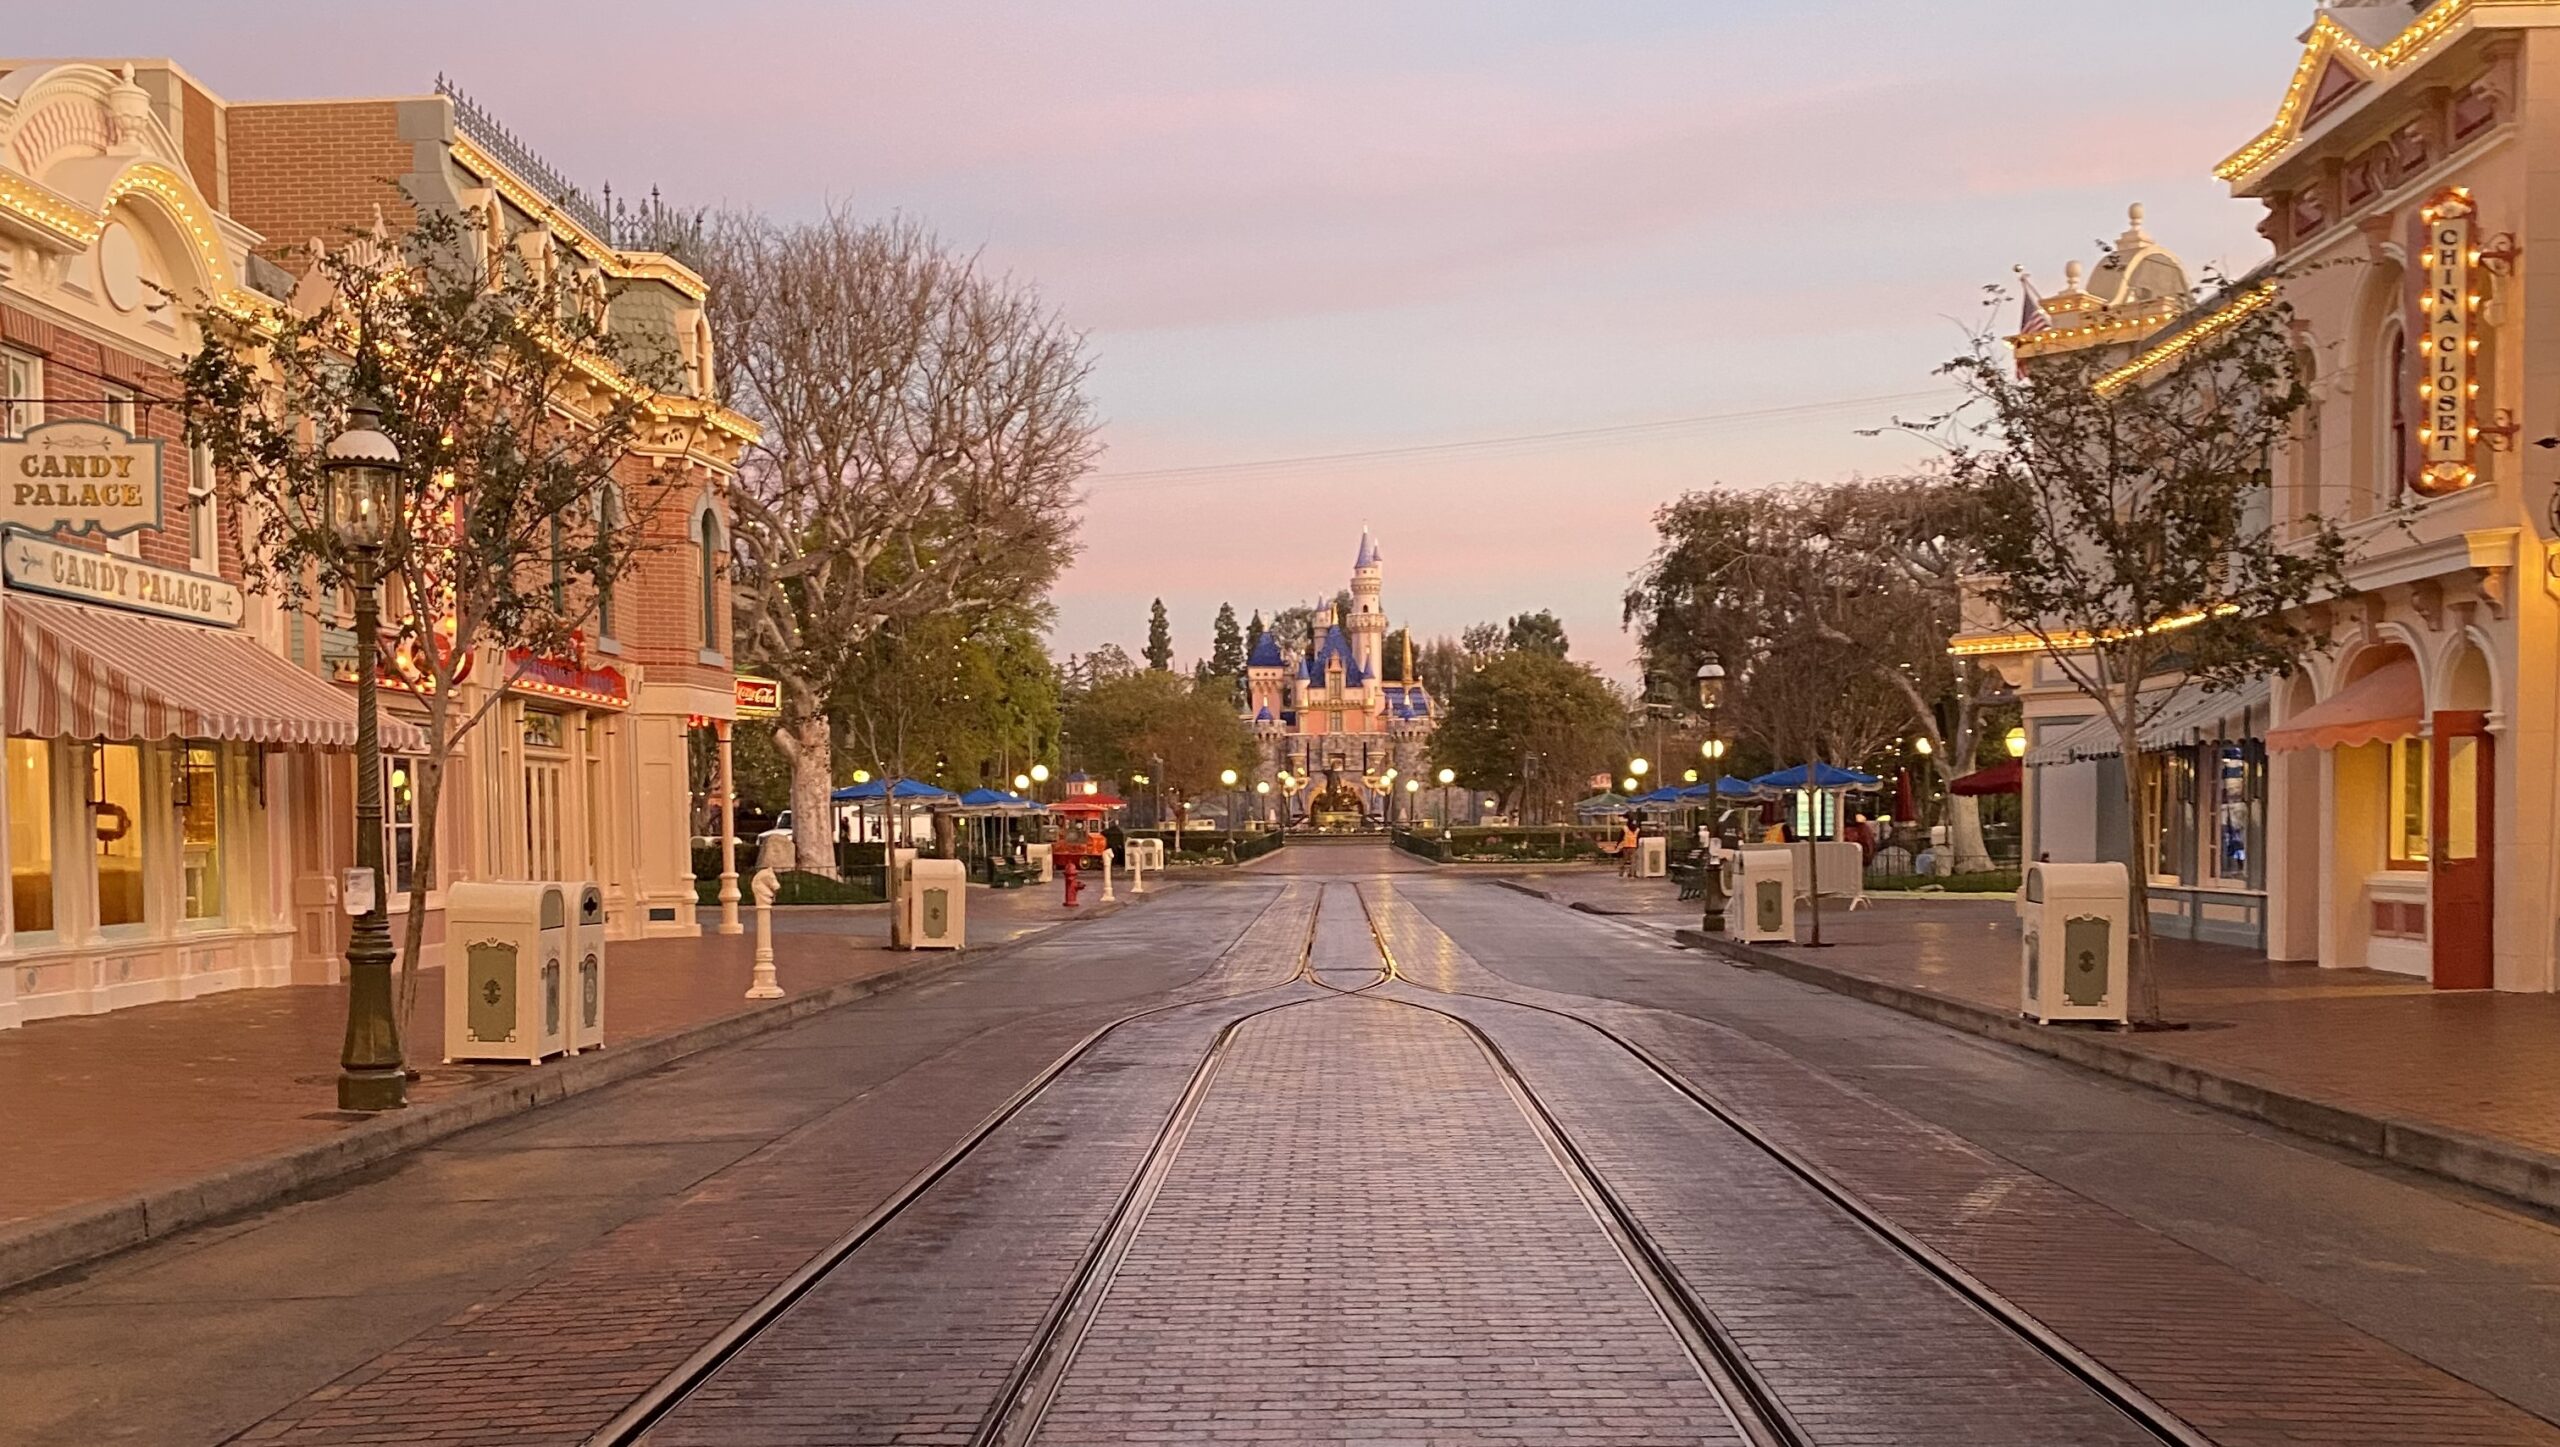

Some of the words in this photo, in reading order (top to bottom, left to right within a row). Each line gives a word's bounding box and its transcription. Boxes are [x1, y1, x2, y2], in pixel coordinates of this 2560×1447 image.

[2437, 229, 2459, 324] CHINA
[2437, 336, 2457, 451] CLOSET
[13, 483, 143, 507] PALACE
[20, 454, 135, 478] CANDY
[52, 550, 128, 596] CANDY
[137, 570, 212, 613] PALACE
